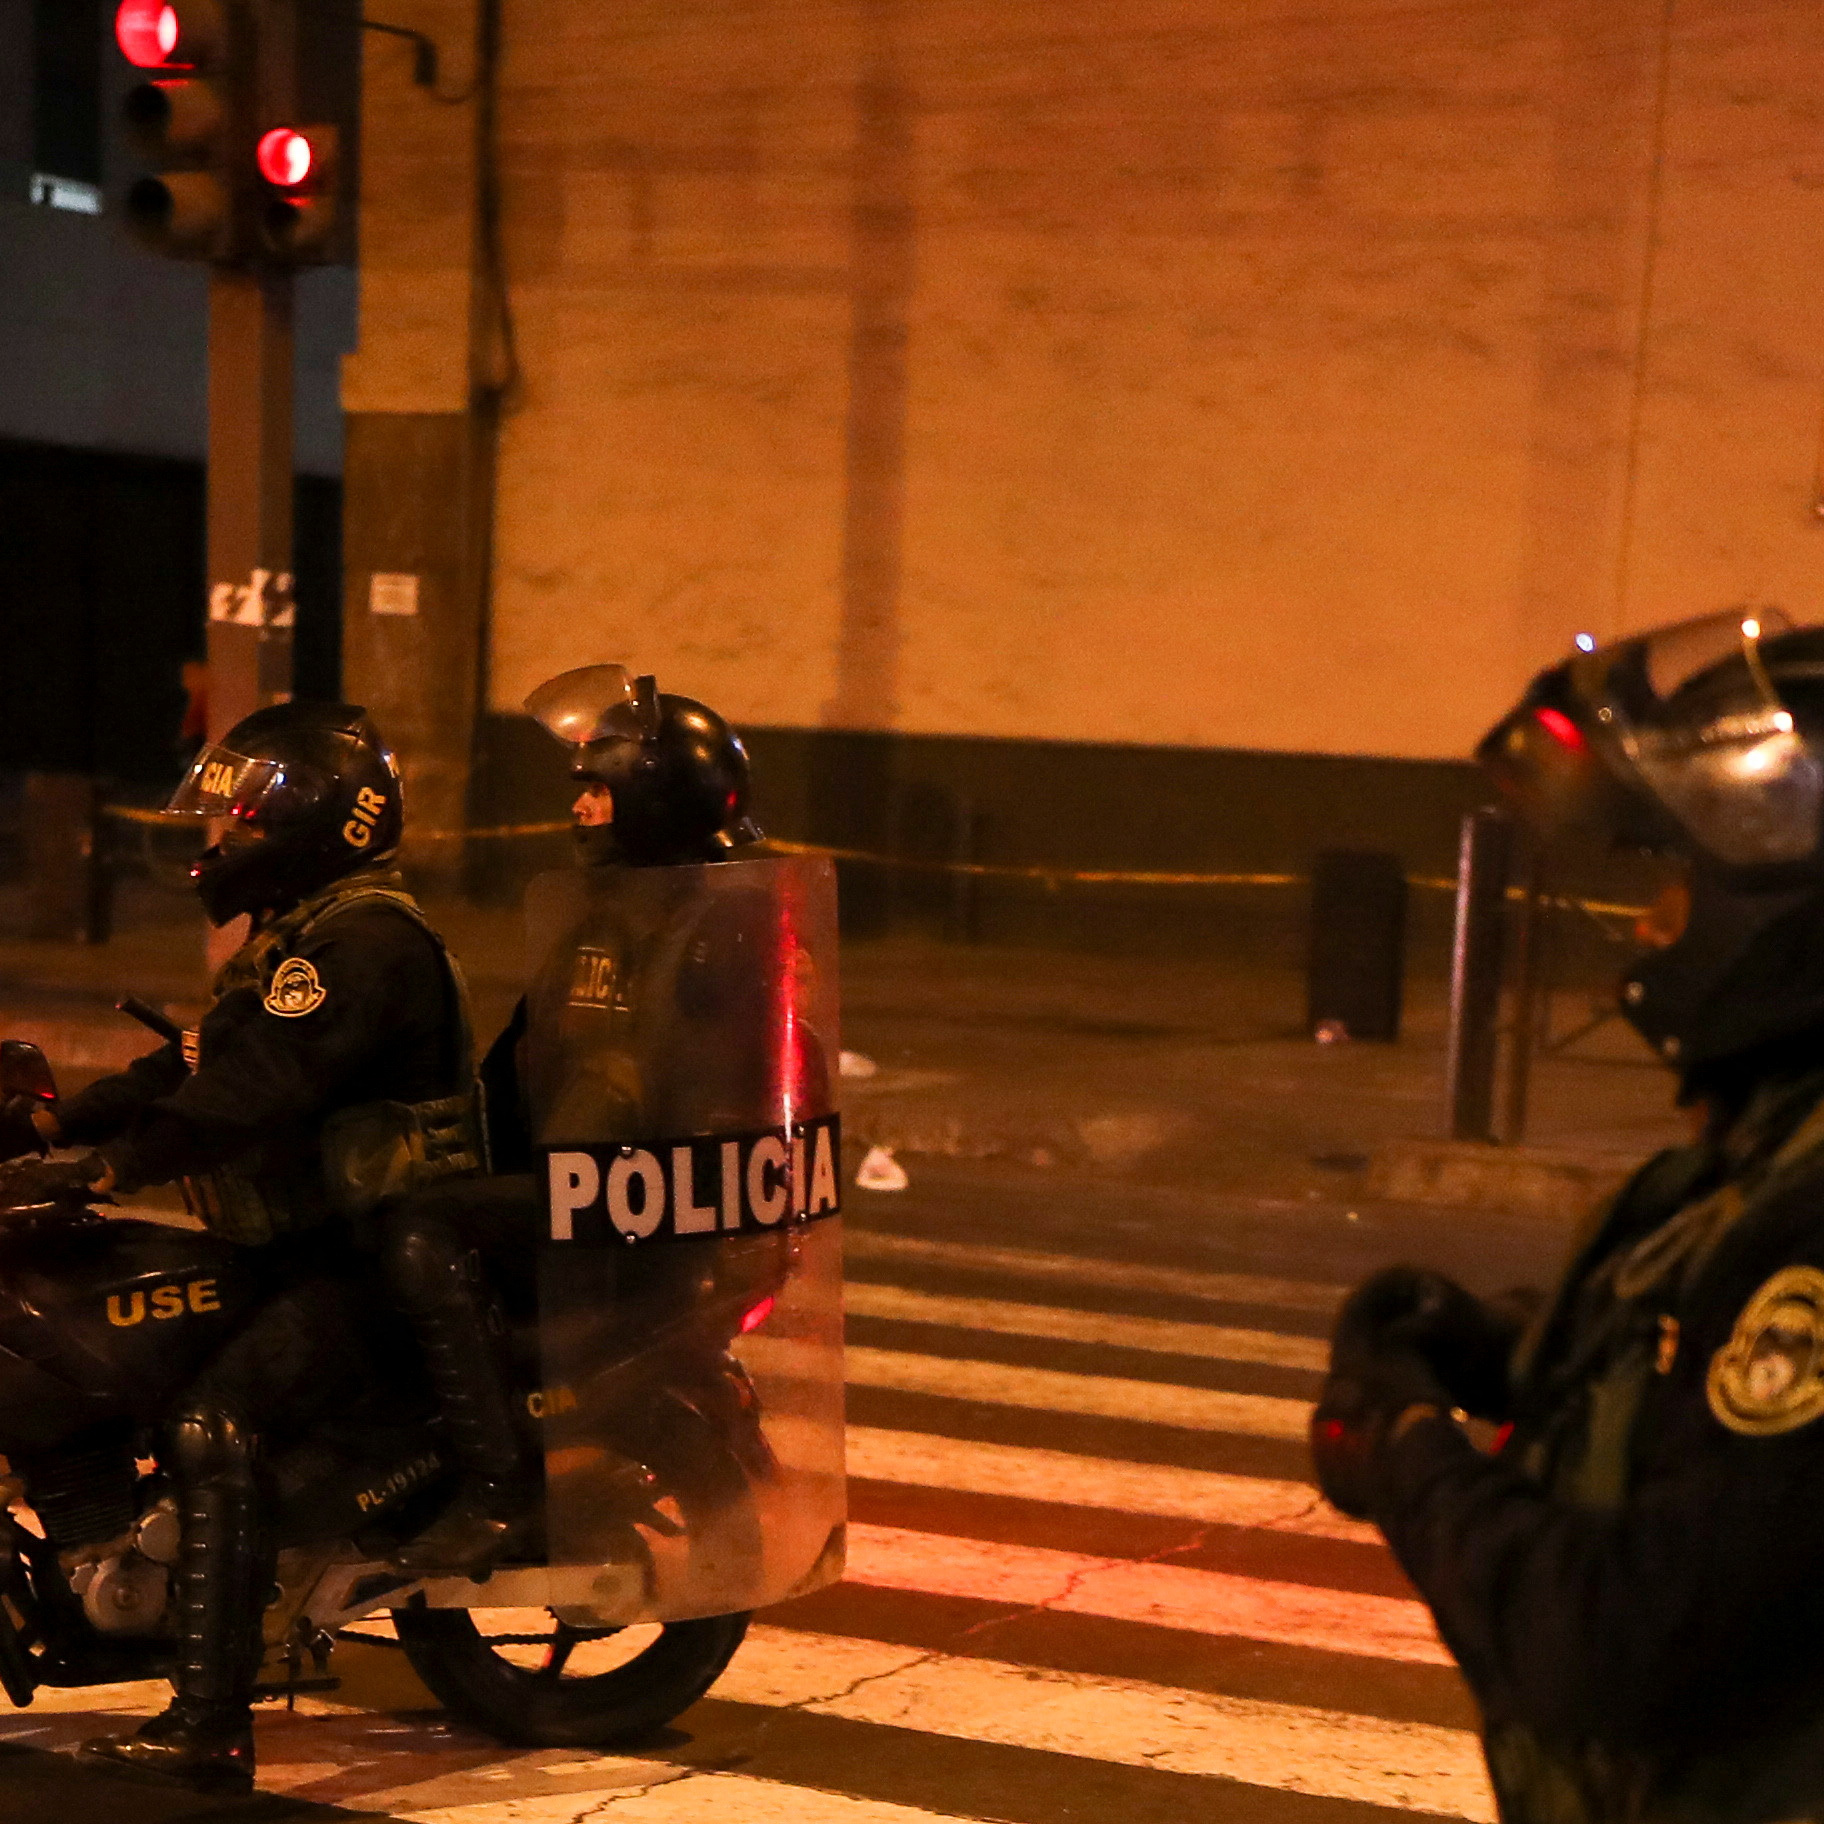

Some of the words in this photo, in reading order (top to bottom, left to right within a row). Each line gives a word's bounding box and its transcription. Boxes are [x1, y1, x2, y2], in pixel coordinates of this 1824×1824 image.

[342, 786, 387, 849] GIR
[547, 1125, 839, 1242] POLICIA
[106, 1278, 222, 1328] USE
